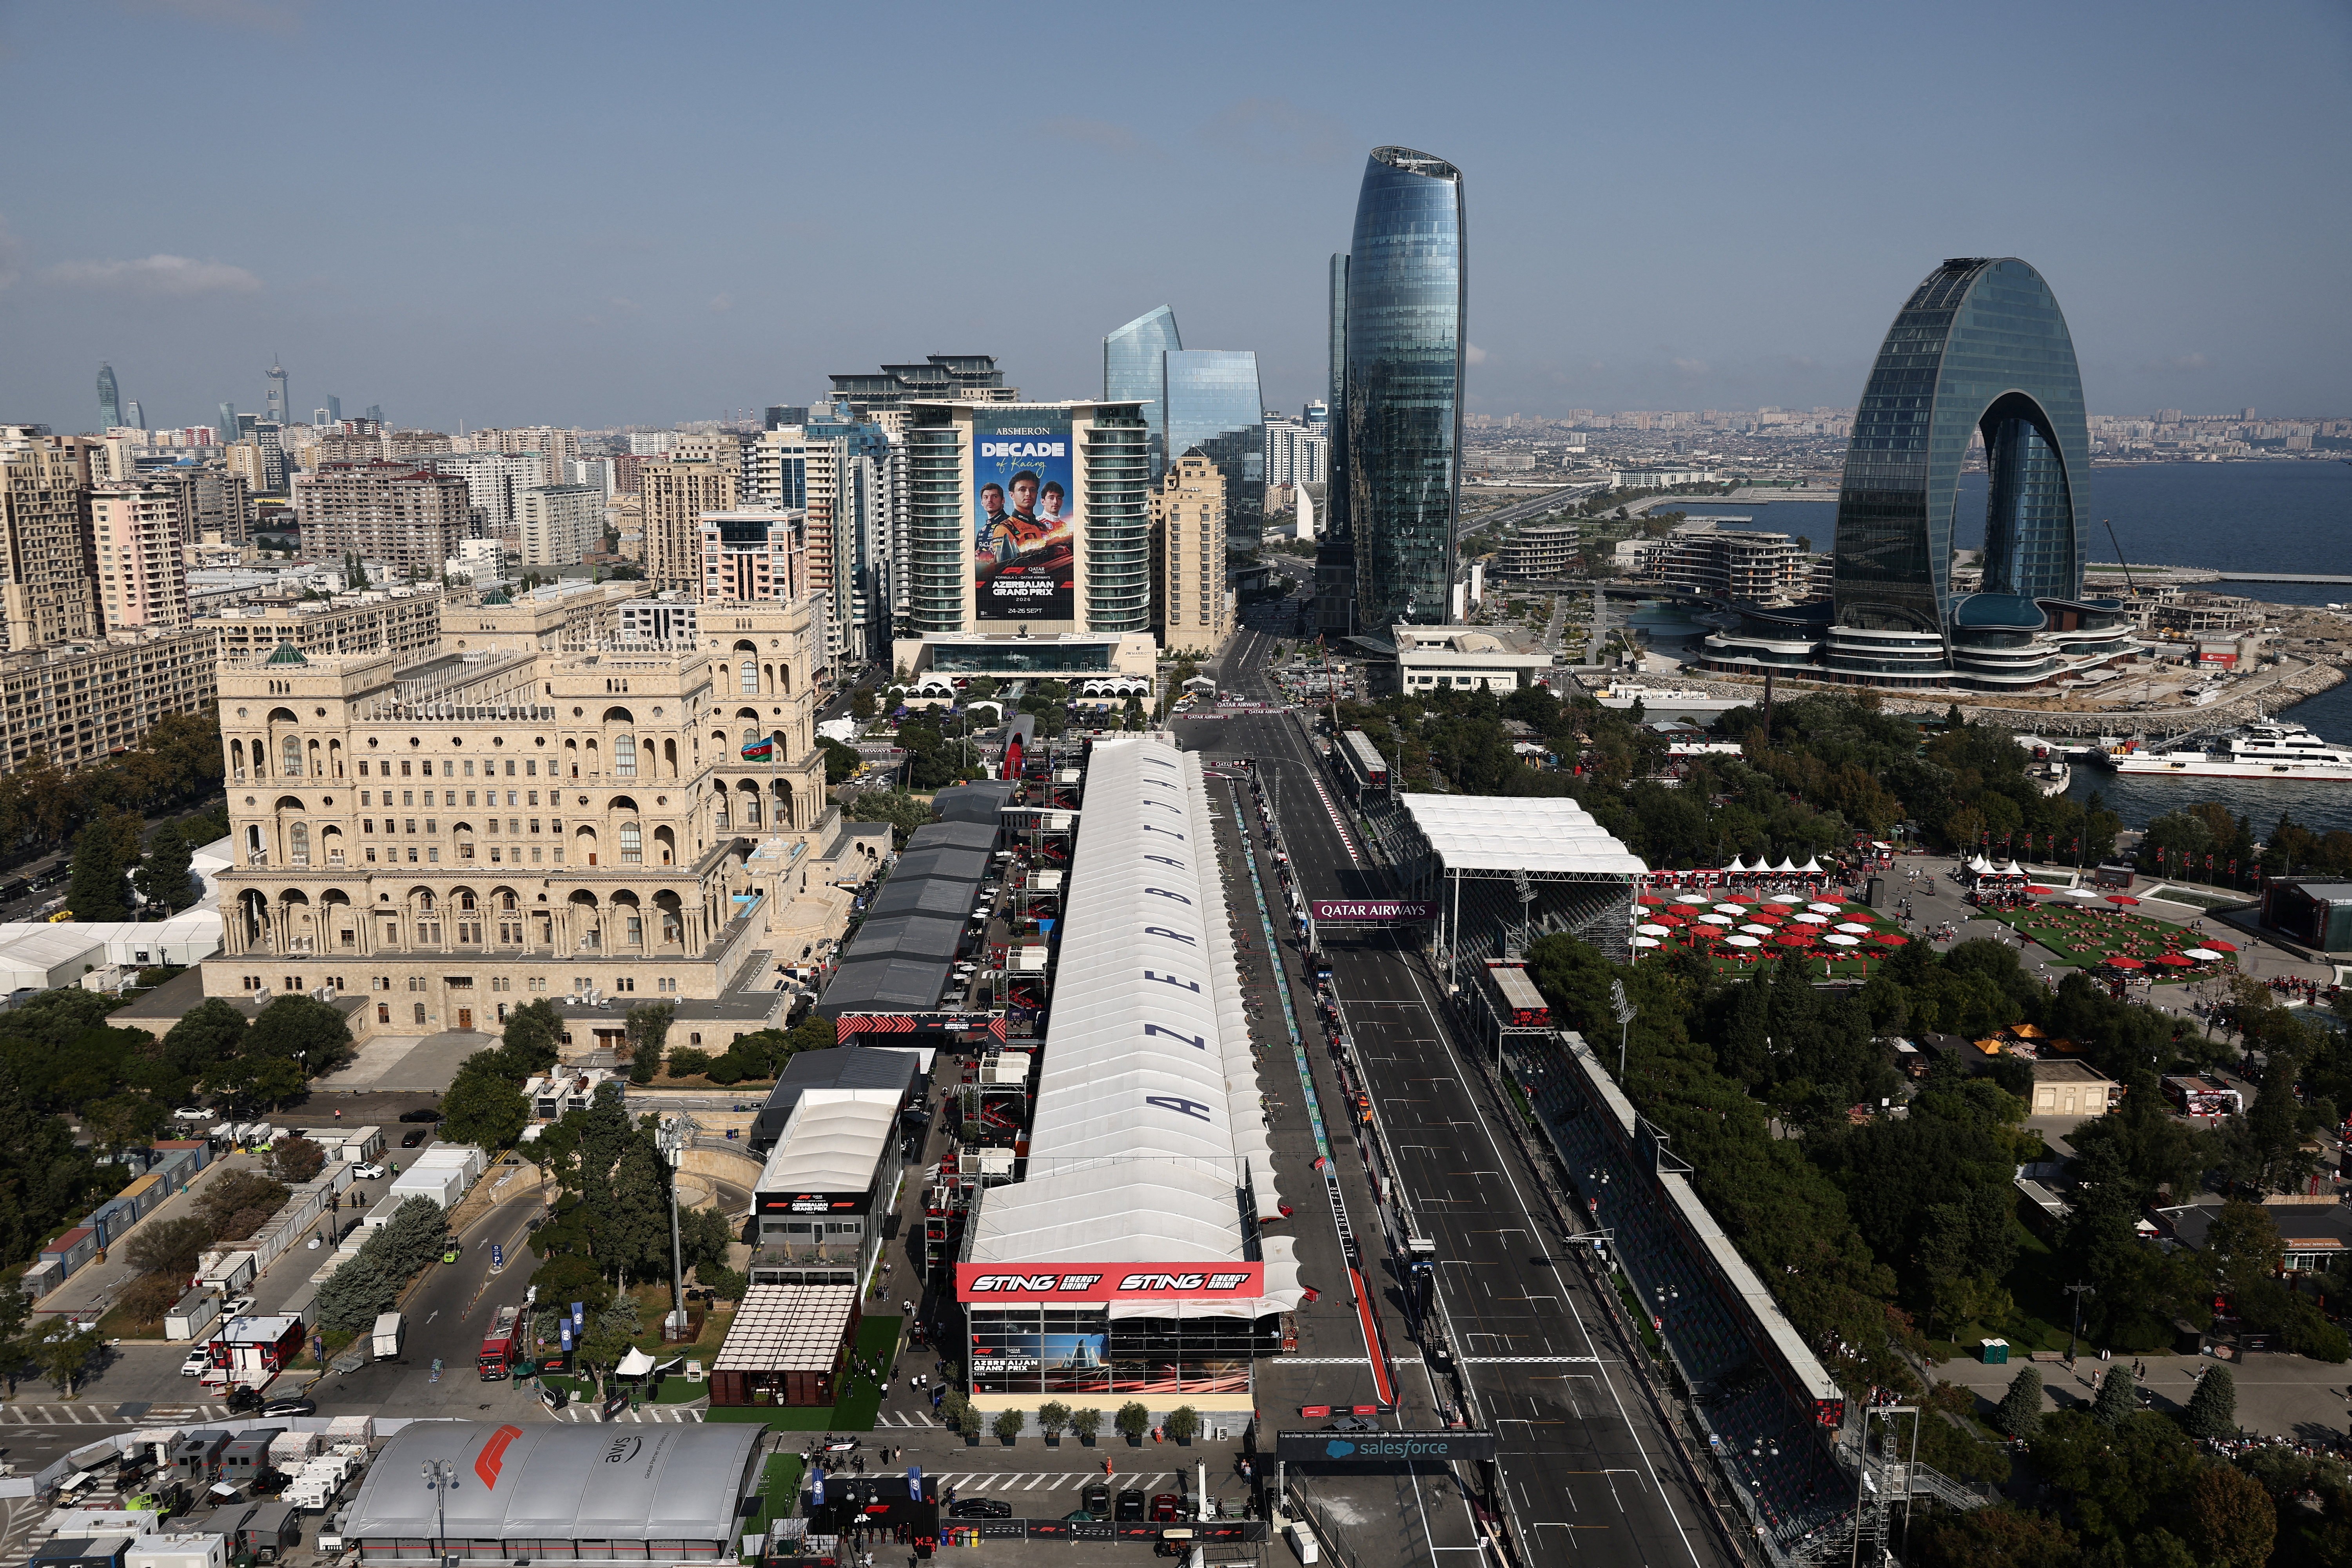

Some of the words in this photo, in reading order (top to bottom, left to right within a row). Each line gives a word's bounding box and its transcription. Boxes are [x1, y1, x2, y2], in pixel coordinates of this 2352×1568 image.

[982, 442, 1065, 457] DECADE
[996, 457, 1007, 474] of
[1011, 454, 1047, 478] Racing
[1321, 905, 1366, 917] QATAR
[1369, 905, 1426, 915] AIRWAYS
[1325, 1161, 1333, 1176] aramco
[1330, 1187, 1340, 1199] FOR
[1334, 1204, 1347, 1227] DRIVE
[1341, 1231, 1350, 1240] TO
[1344, 1243, 1355, 1257] ALL
[972, 1275, 1058, 1291] STING
[1059, 1281, 1089, 1290] DRINK
[1120, 1274, 1205, 1290] STING
[1207, 1281, 1236, 1289] DRINK
[605, 1437, 631, 1463] aws
[1360, 1439, 1448, 1458] salesforce
[644, 1465, 653, 1479] Global
[650, 1450, 659, 1465] Partner
[1670, 1428, 1683, 1456] QATAR
[1684, 1454, 1700, 1488] AIRWAYS
[1707, 1500, 1722, 1531] QATAR
[1722, 1529, 1742, 1568] AIRWAYS
